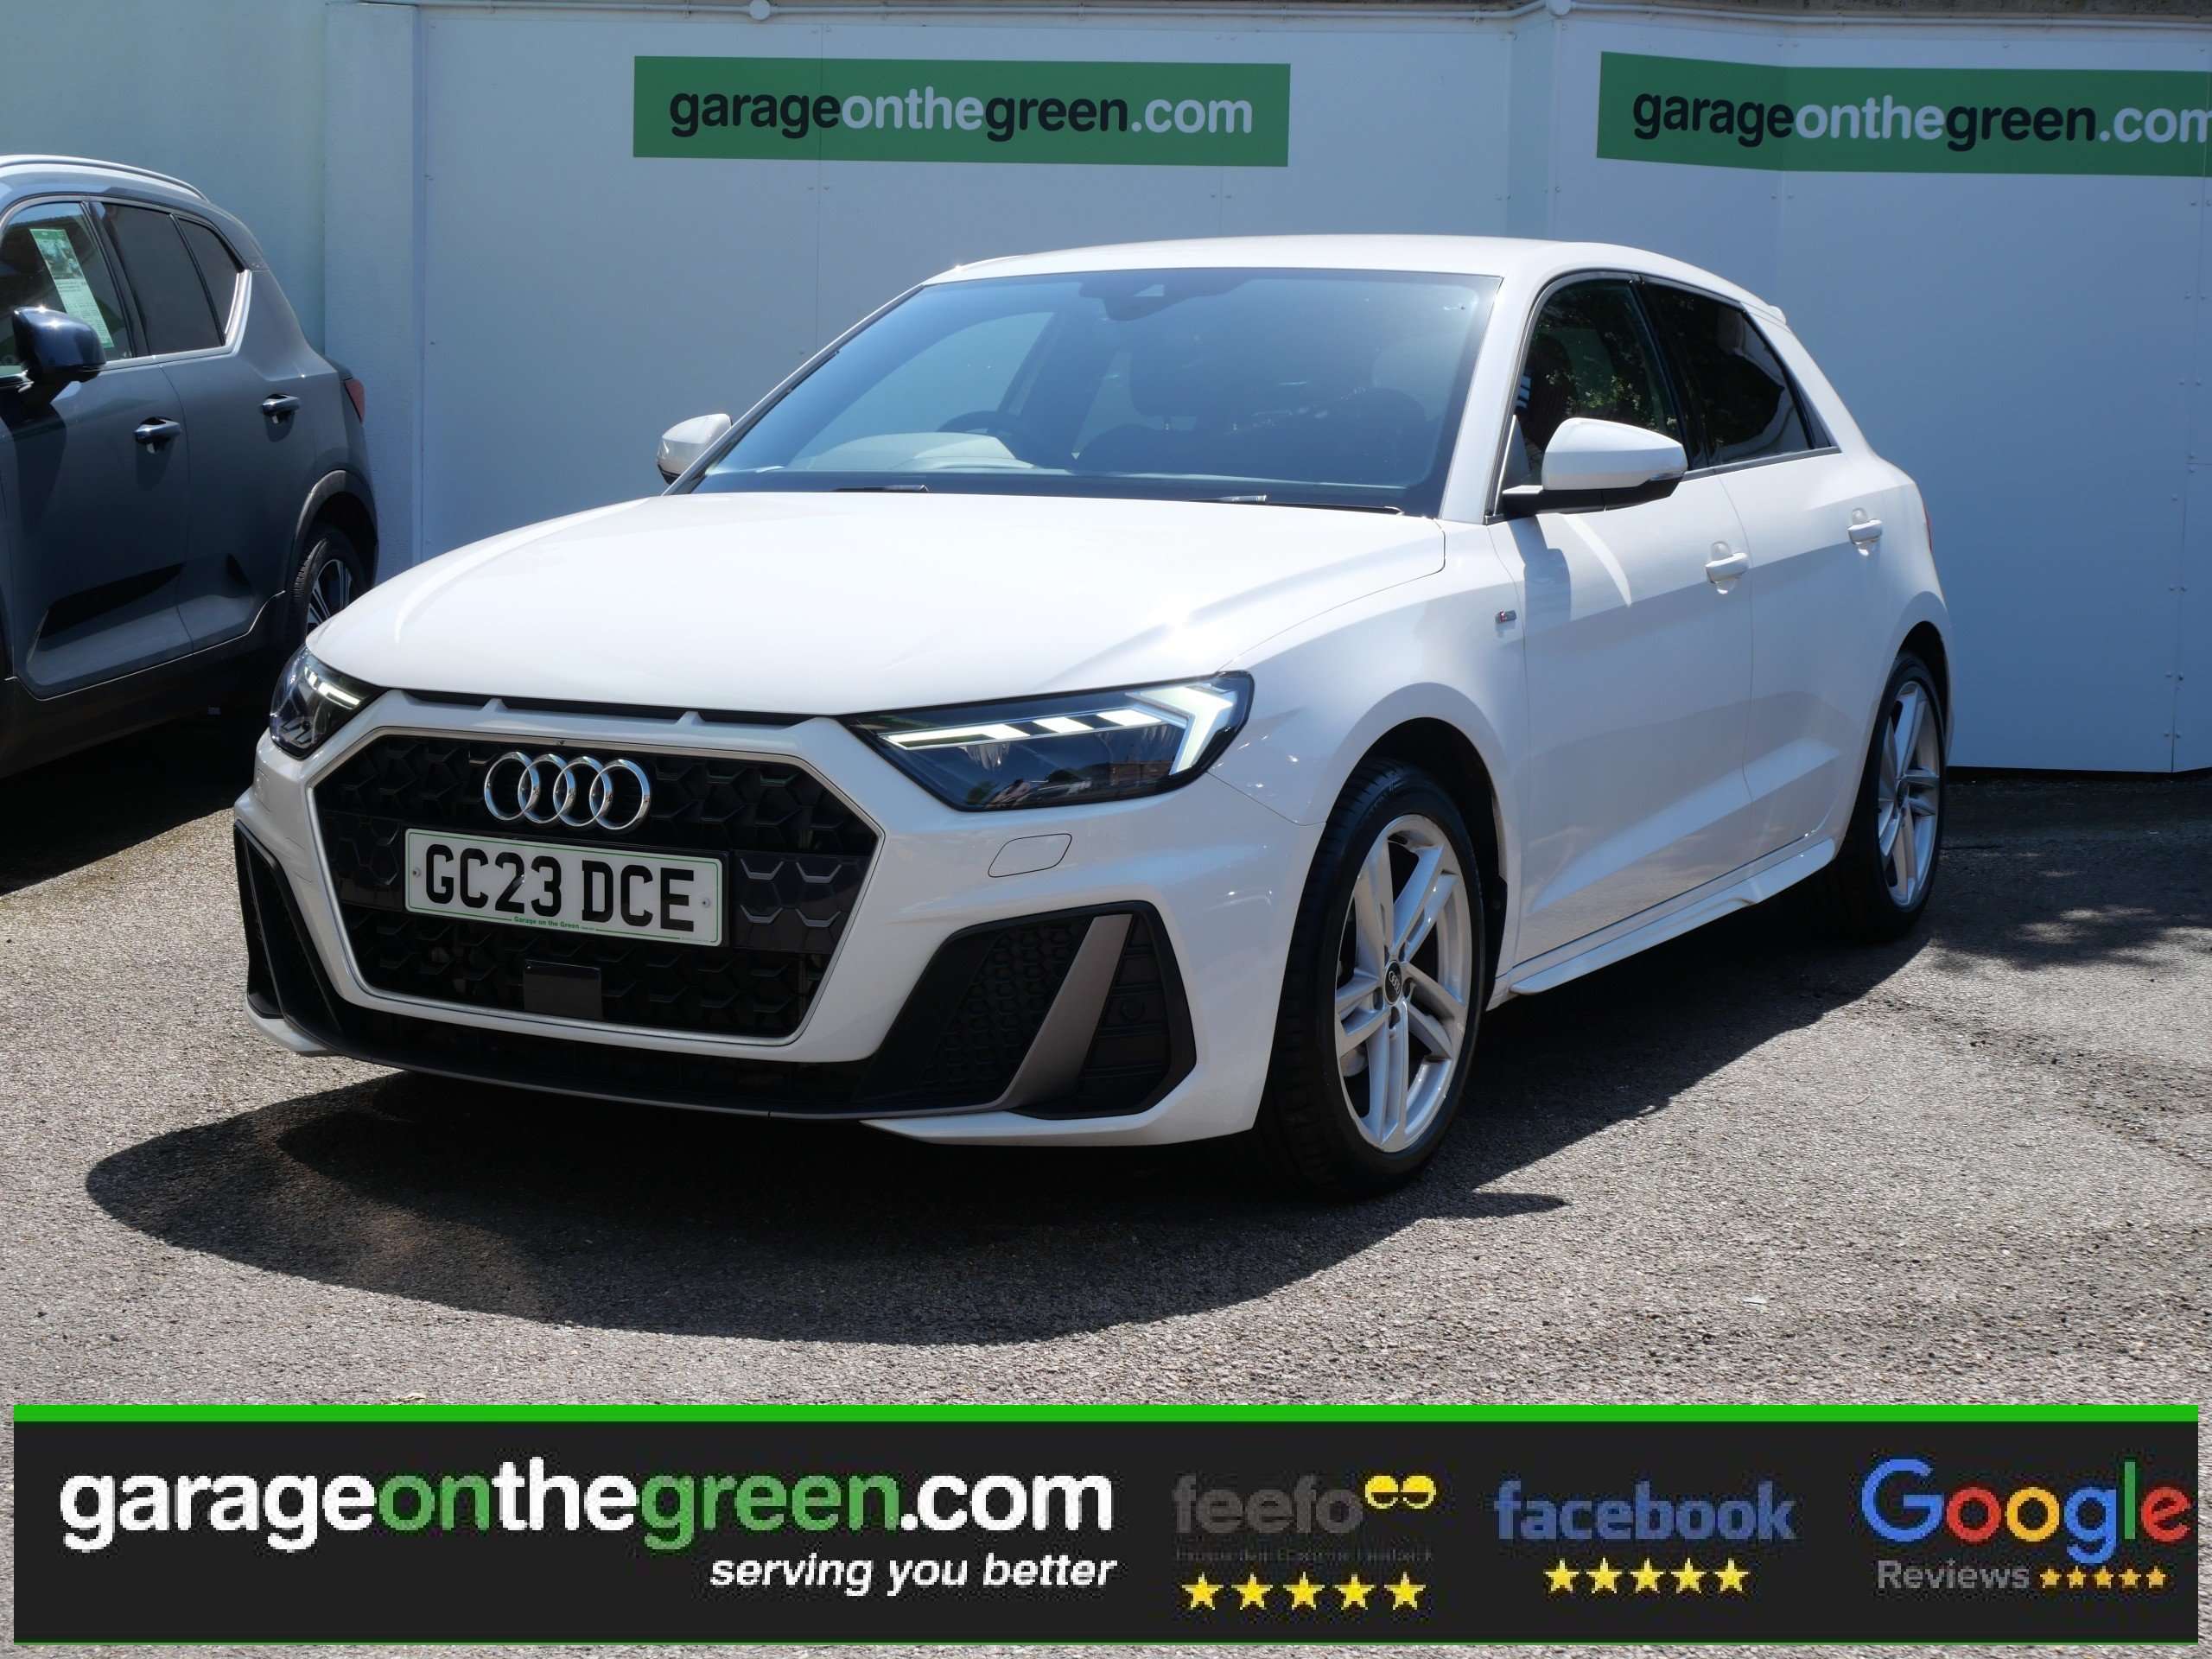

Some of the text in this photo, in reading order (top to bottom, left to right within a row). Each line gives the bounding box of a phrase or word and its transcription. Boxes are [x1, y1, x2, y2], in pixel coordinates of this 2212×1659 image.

[670, 86, 1252, 142] garageonthegreen.com
[426, 843, 695, 932] GC23 DCE
[514, 916, 537, 925] Garage
[560, 921, 580, 930] Green
